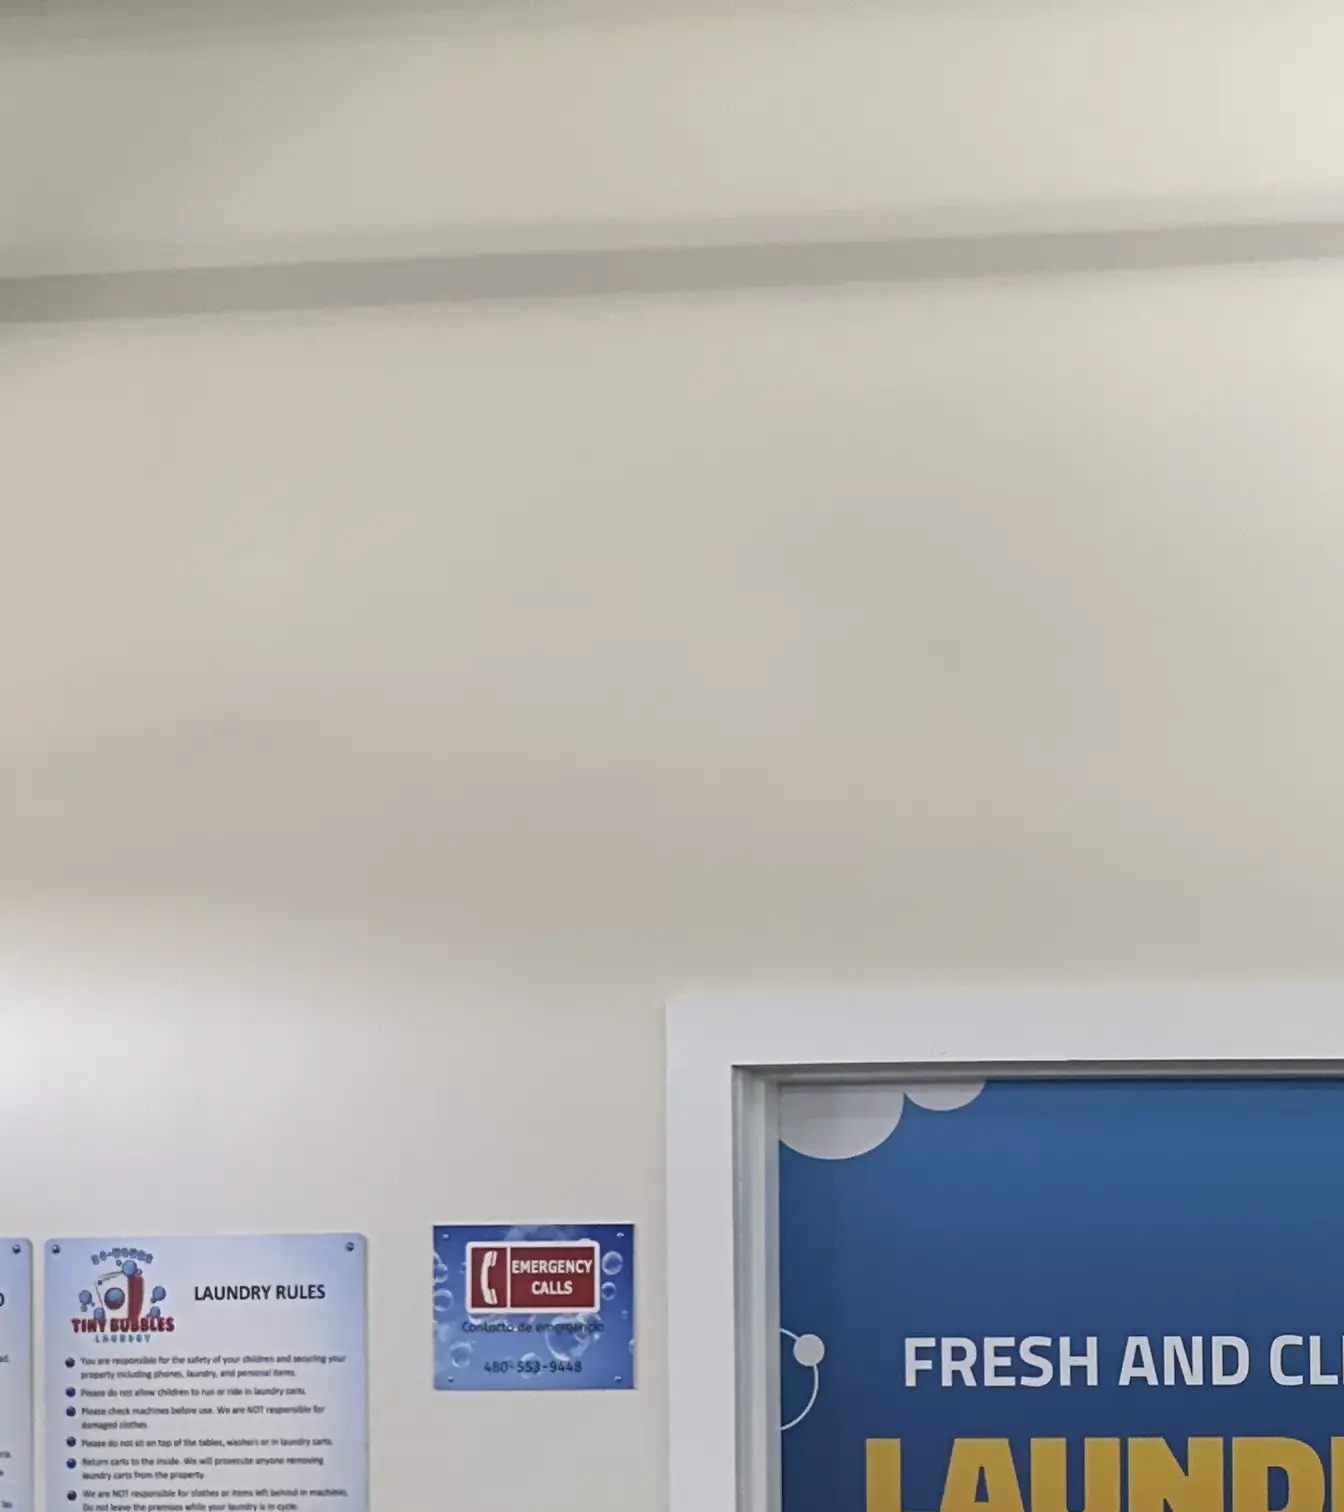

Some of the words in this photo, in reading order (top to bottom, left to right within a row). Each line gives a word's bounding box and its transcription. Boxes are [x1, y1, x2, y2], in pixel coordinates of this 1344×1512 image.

[511, 1259, 592, 1273] EMERGENCY
[194, 1285, 271, 1300] LAUNDRY
[275, 1284, 326, 1299] RULES
[531, 1280, 573, 1295] CALLS
[71, 1318, 107, 1333] TINY
[110, 1317, 175, 1332] BUBBLES
[518, 1322, 533, 1333] de
[904, 1335, 1098, 1388] FRESH
[1118, 1335, 1250, 1387] AND
